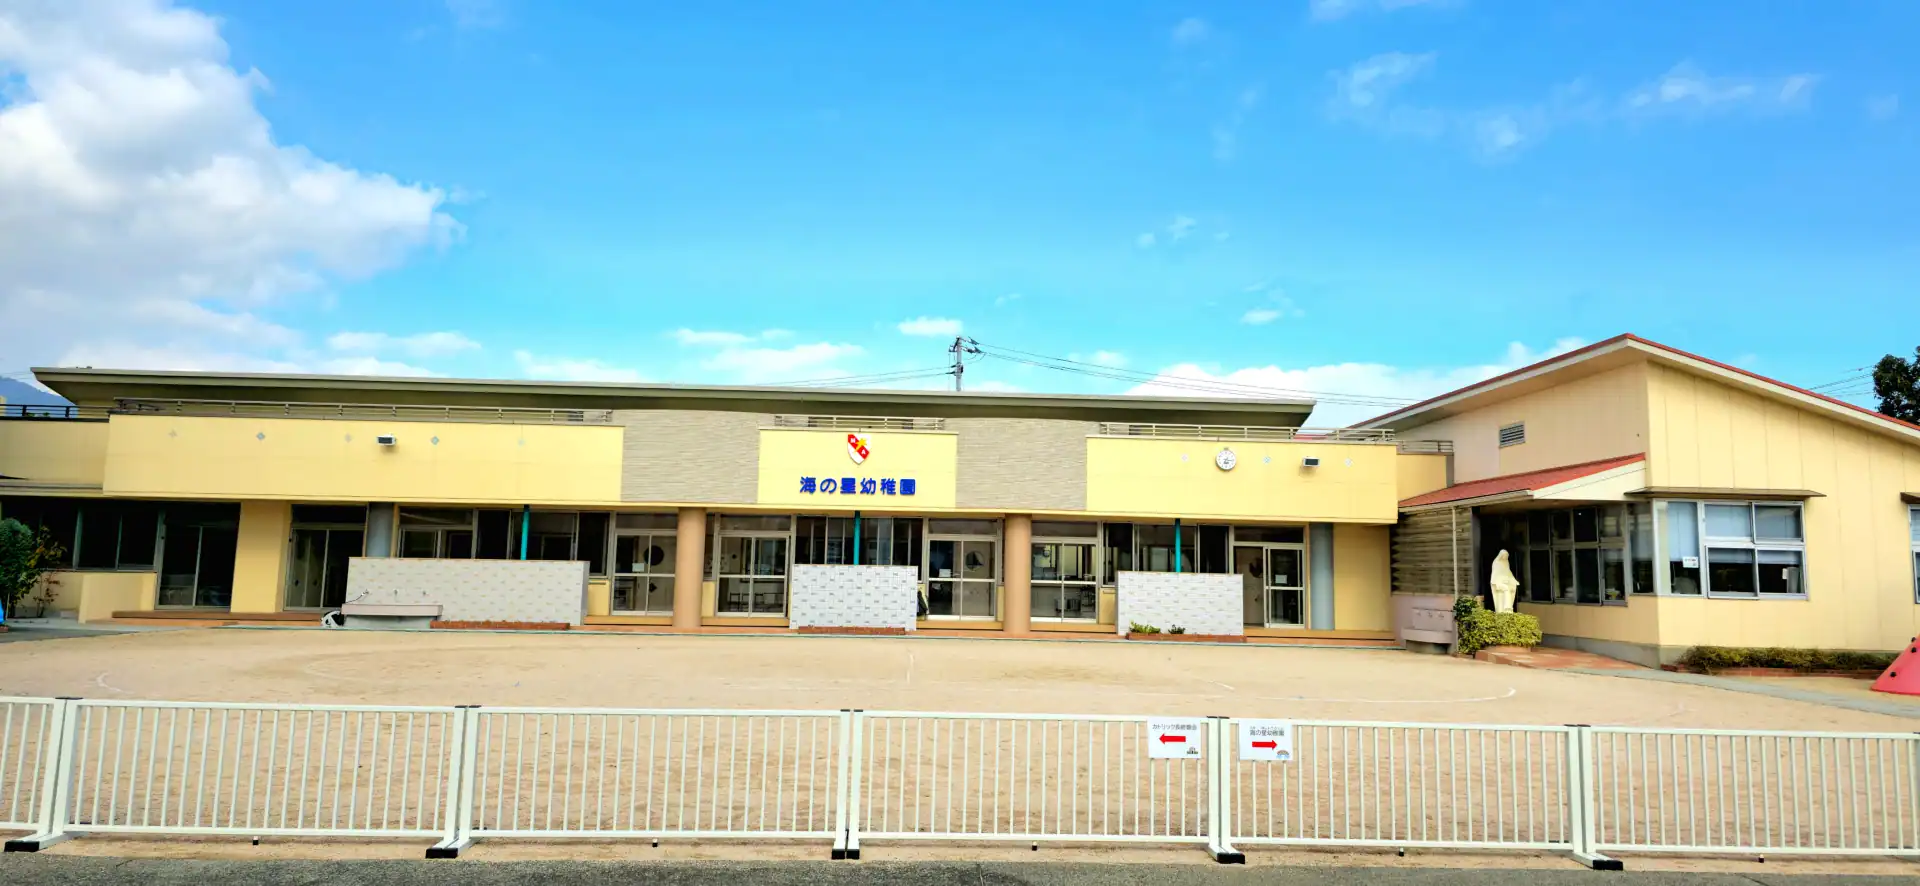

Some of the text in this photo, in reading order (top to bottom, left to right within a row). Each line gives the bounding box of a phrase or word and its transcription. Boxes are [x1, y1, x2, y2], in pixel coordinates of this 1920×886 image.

[800, 476, 916, 496] 海の星幼稚園
